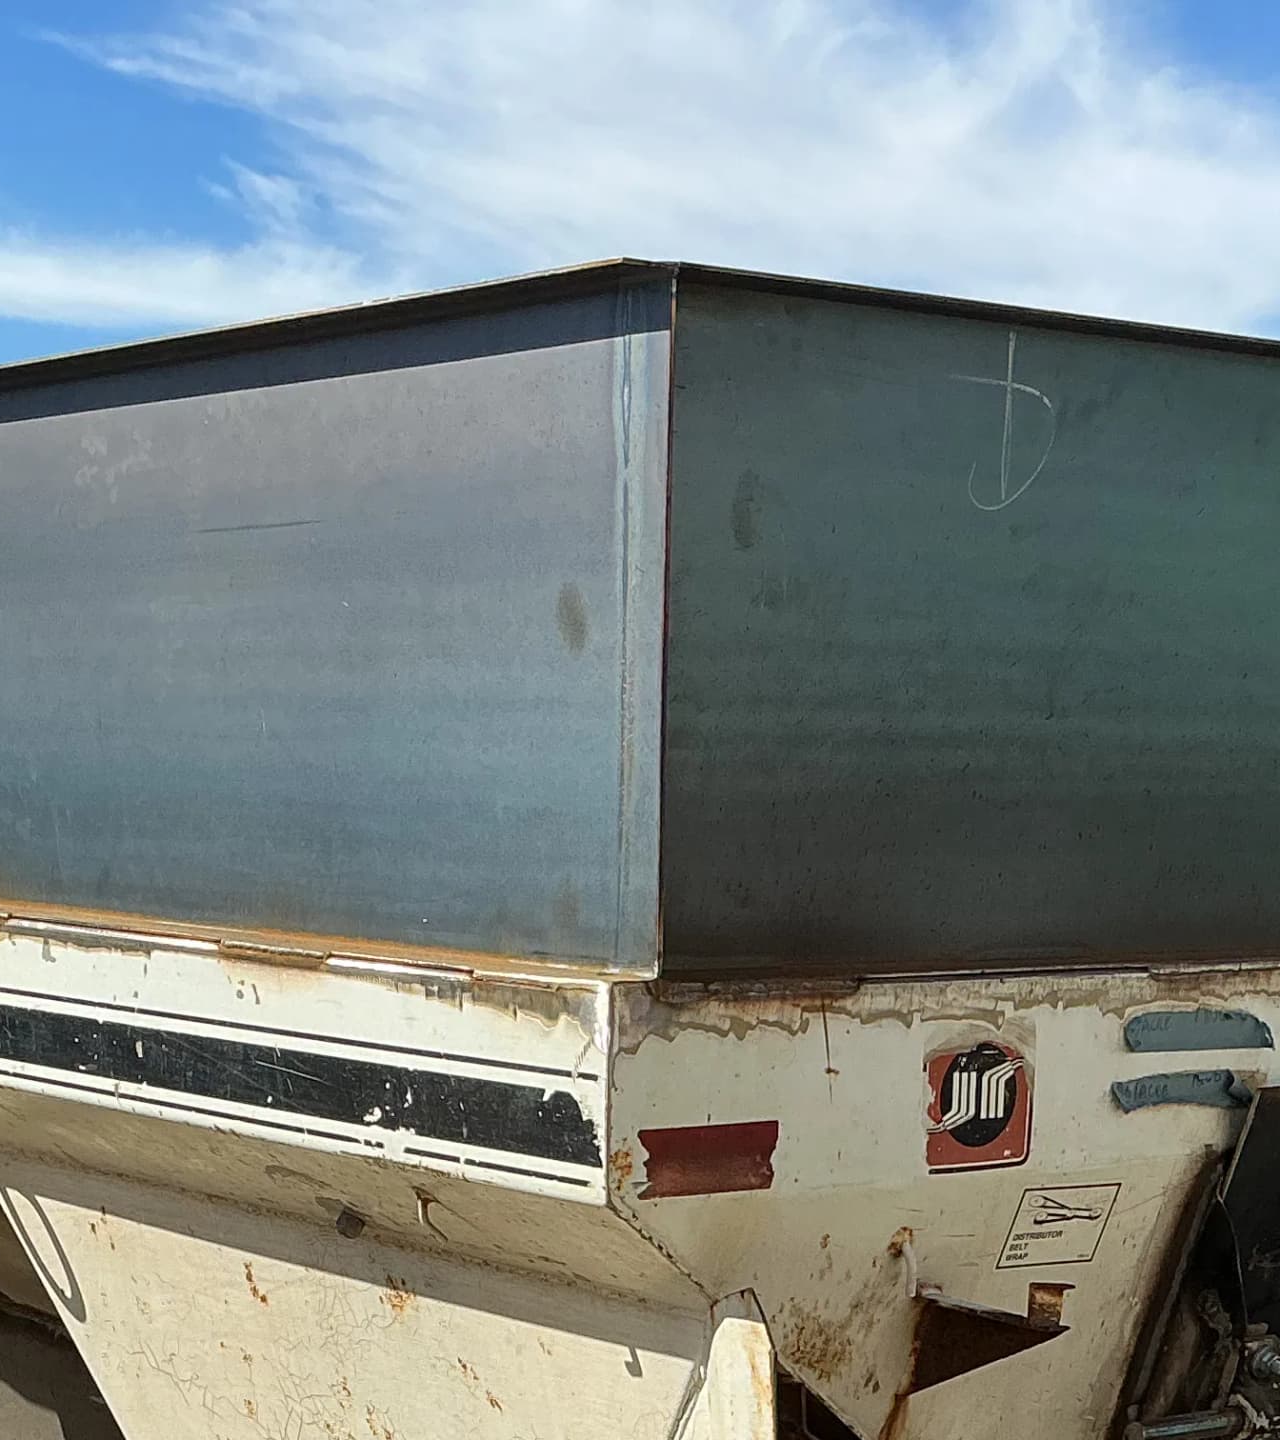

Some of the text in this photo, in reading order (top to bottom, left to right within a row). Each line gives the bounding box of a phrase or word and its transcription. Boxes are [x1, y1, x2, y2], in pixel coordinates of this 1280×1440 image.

[1012, 1230, 1064, 1241] DISTRIBUTOR
[1009, 1242, 1029, 1252] BELT
[1005, 1252, 1029, 1261] WRAP
